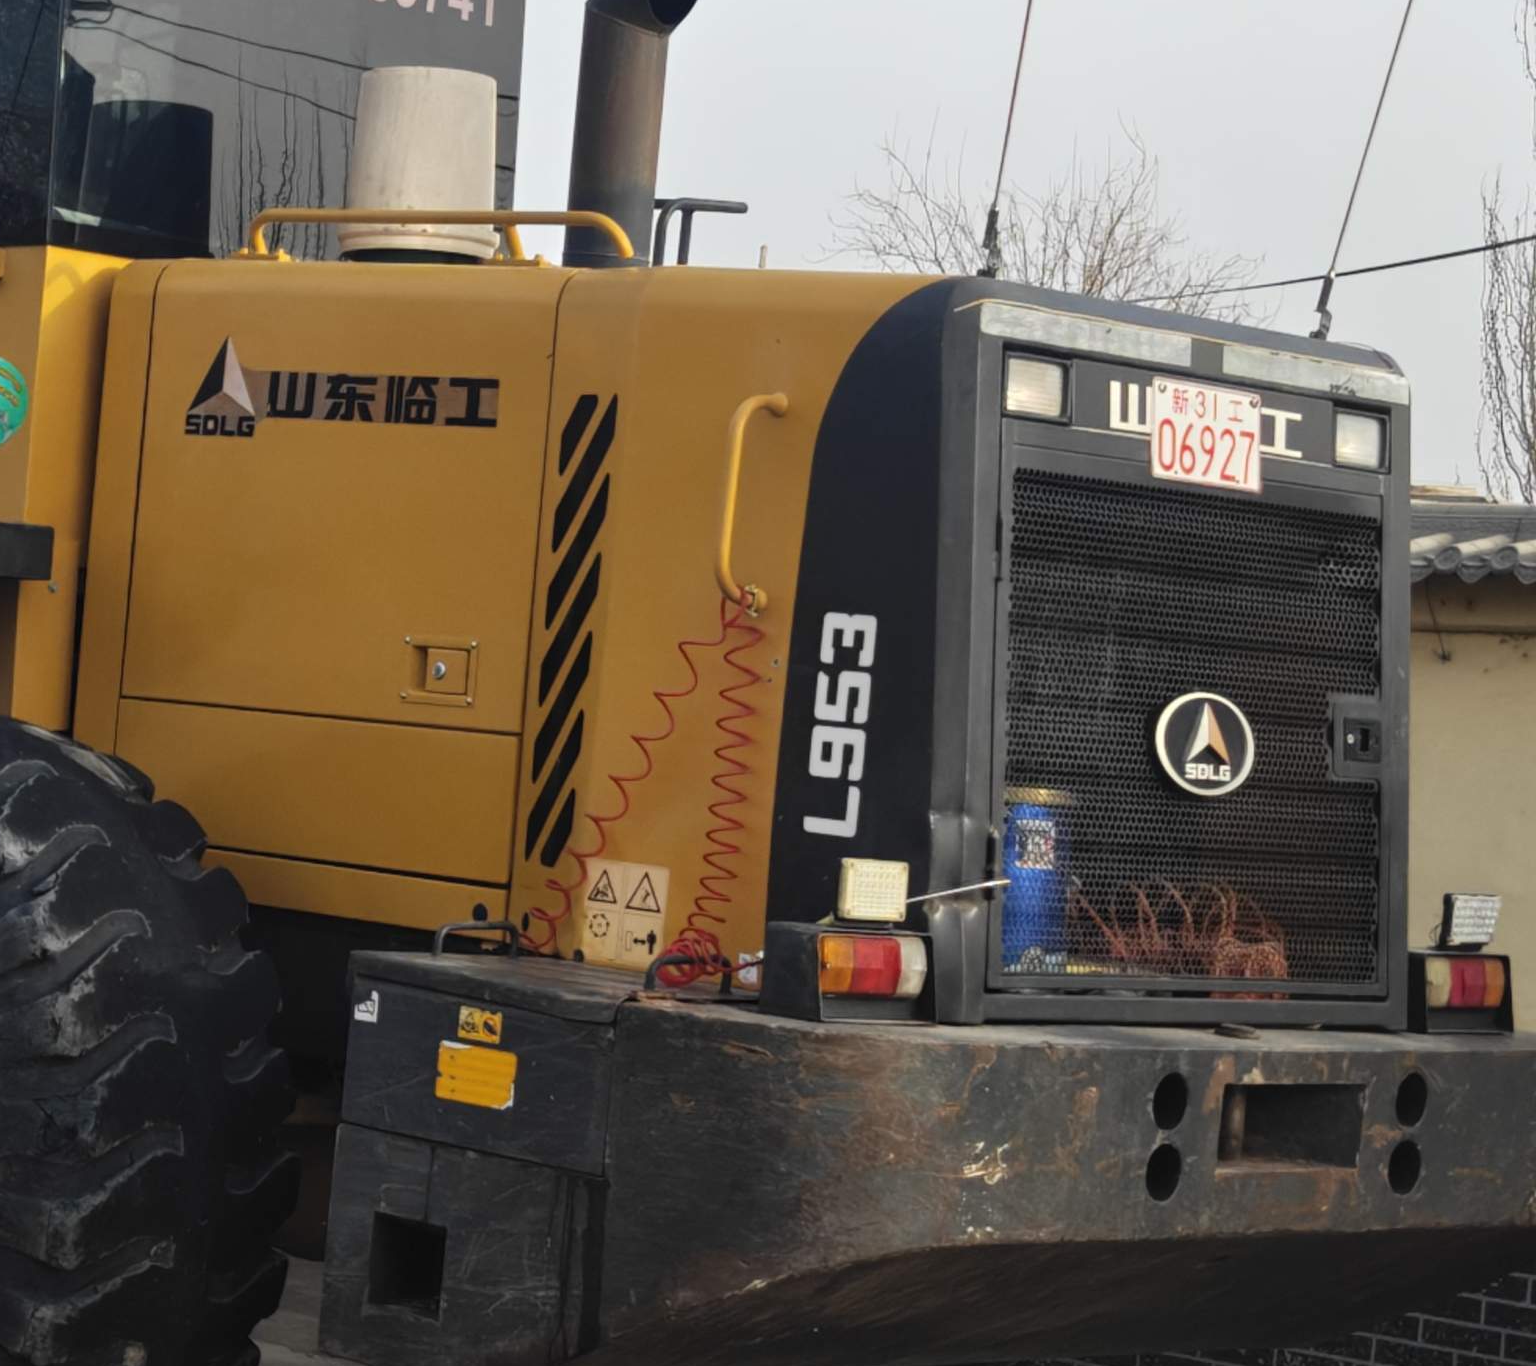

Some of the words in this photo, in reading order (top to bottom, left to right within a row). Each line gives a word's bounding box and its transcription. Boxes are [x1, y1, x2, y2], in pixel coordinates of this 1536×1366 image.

[184, 413, 256, 438] SDLG
[267, 370, 500, 428] 山东临工
[1158, 417, 1256, 485] 06927
[802, 611, 878, 838] L953
[1184, 762, 1232, 782] SDLG
